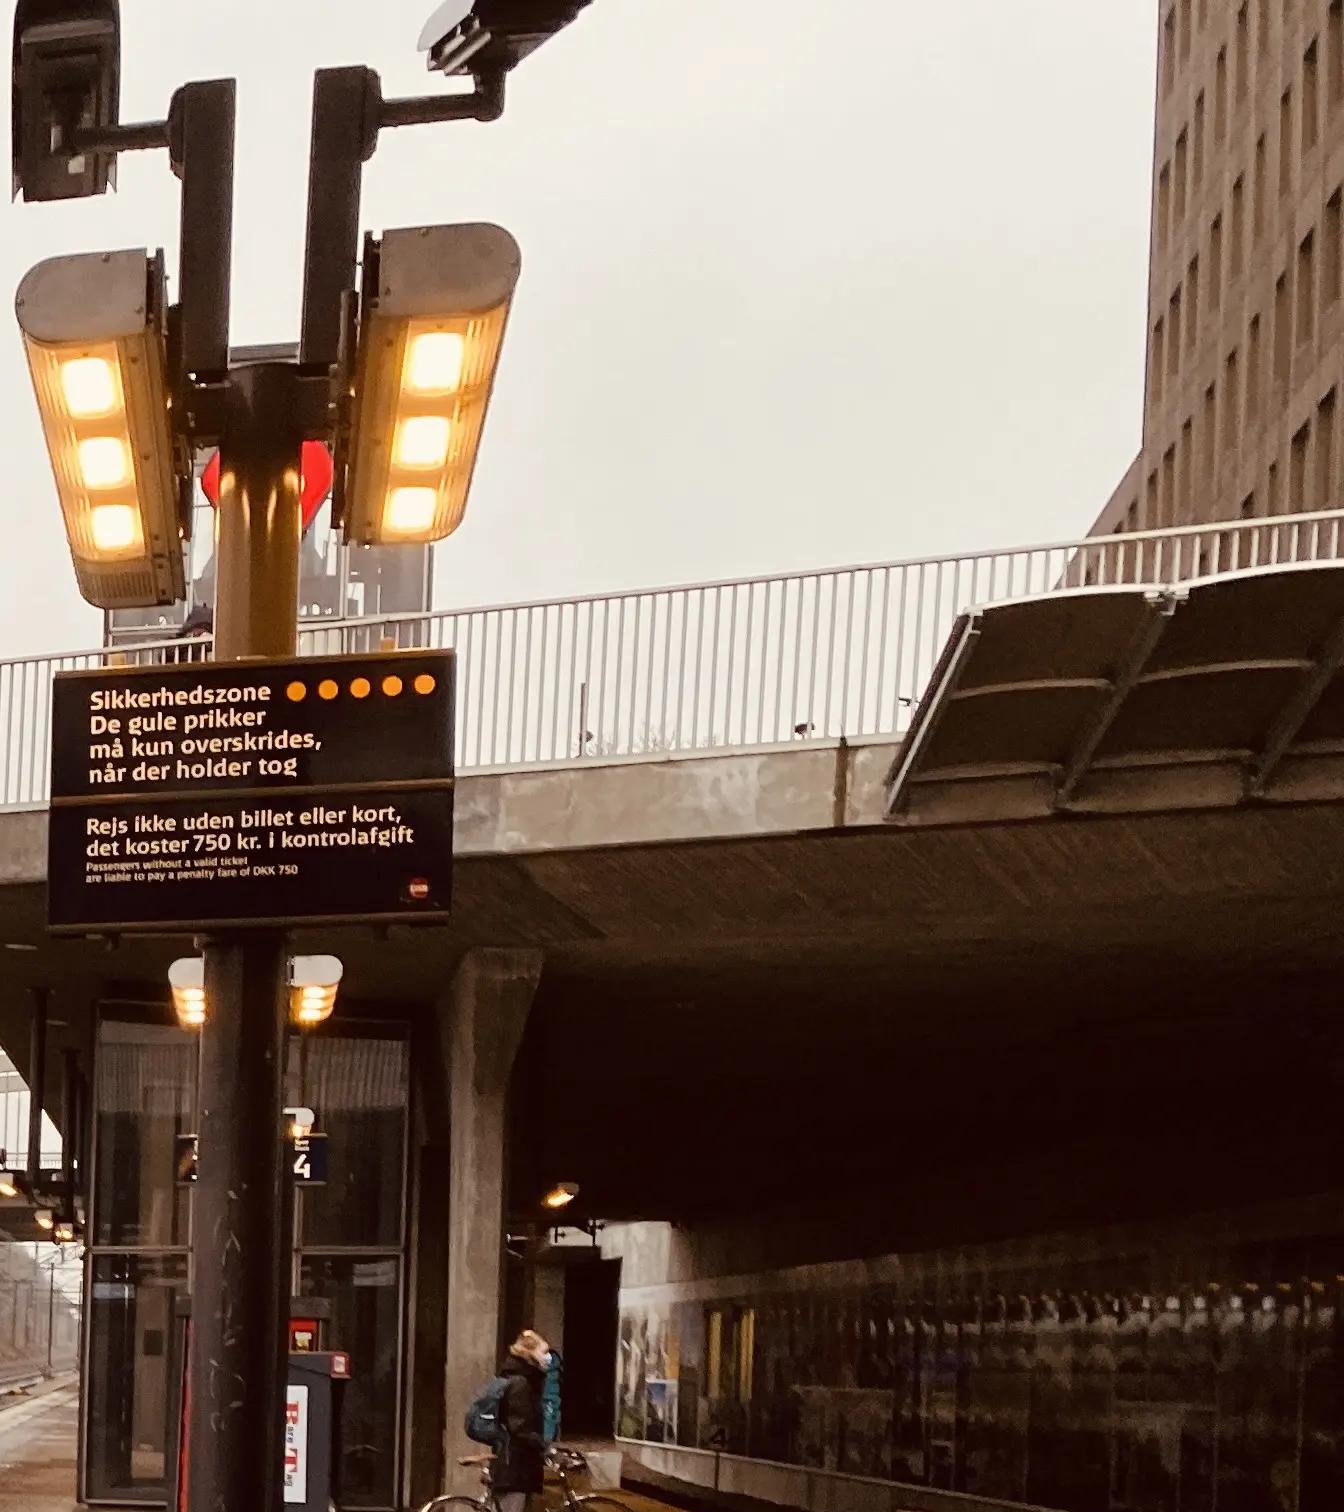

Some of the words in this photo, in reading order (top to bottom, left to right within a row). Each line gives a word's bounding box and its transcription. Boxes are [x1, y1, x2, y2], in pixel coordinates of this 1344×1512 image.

[90, 685, 271, 711] Sikkerhedszone
[90, 715, 121, 735] De
[128, 712, 177, 736] gule
[184, 708, 267, 734] prikker
[89, 738, 124, 759] må
[132, 737, 174, 757] kun
[180, 729, 322, 755] overskrides,
[89, 762, 127, 784] når
[132, 762, 171, 782] der
[176, 758, 252, 779] holder
[258, 757, 297, 778] tog
[86, 817, 129, 838] Rejs
[134, 814, 177, 832] ikke
[183, 812, 234, 830] uden
[241, 809, 294, 828] billet
[299, 806, 347, 825] eller
[352, 805, 402, 824] kort,
[86, 839, 120, 857] det
[125, 838, 190, 855] koster
[192, 833, 231, 852] 750
[237, 832, 262, 850] kr.
[268, 831, 275, 849] i
[281, 825, 414, 848] kontrolafgift
[85, 874, 102, 883] are
[104, 872, 132, 883] liable
[134, 872, 146, 881] to
[147, 872, 166, 883] pay
[167, 871, 175, 880] a
[177, 868, 215, 881] penalty
[217, 867, 238, 878] fare
[239, 866, 251, 877] of
[253, 865, 276, 877] DKK
[278, 864, 299, 876] 750
[86, 861, 140, 872] Passengers
[142, 859, 182, 870] without
[184, 859, 191, 868] a
[193, 856, 218, 867] valid
[220, 855, 248, 866] ticket
[293, 1153, 311, 1179] 4
